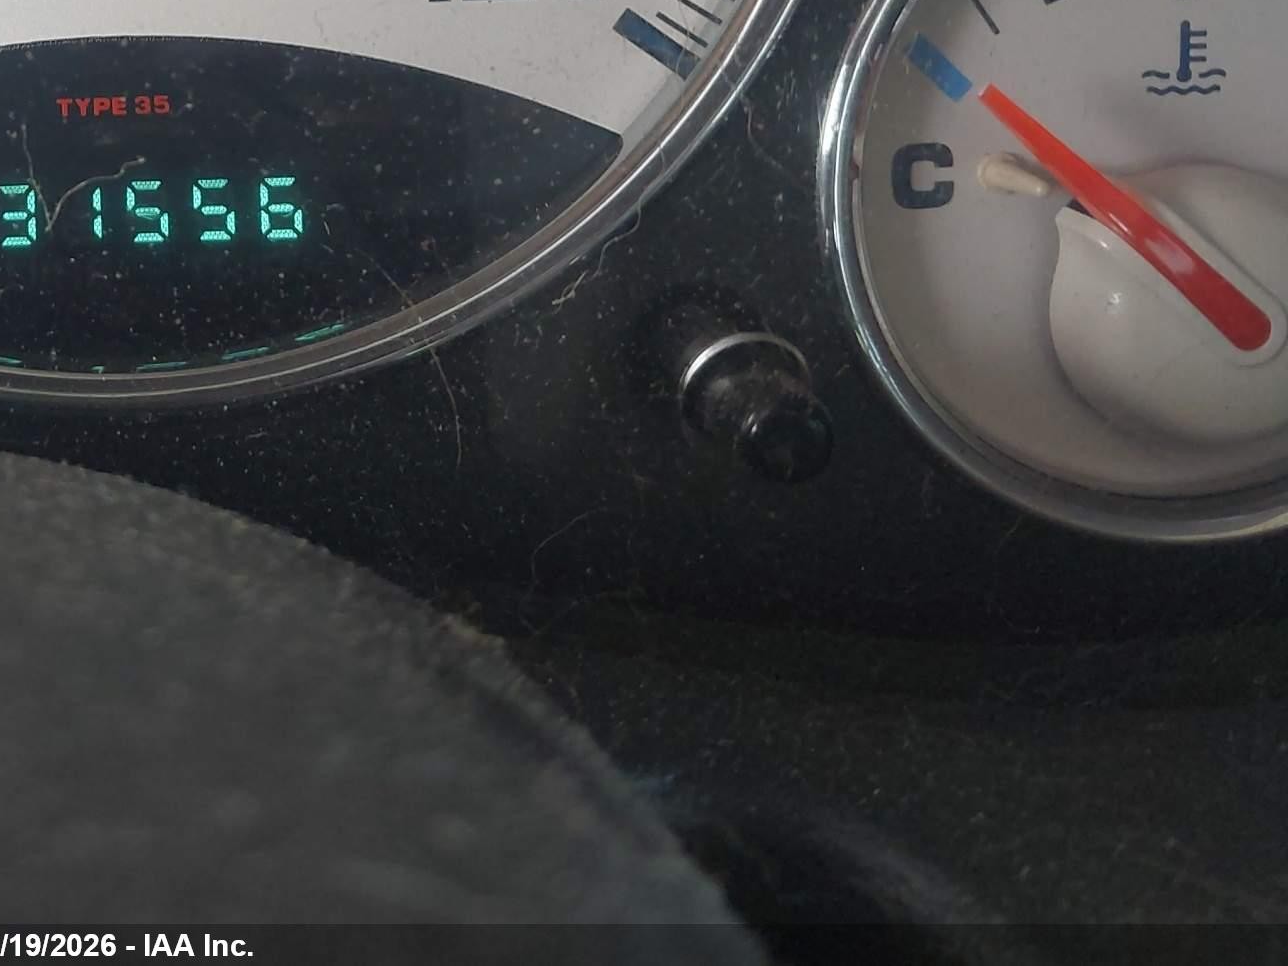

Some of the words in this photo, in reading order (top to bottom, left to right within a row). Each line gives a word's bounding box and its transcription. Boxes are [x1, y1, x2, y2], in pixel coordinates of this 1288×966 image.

[57, 97, 127, 118] TYPE
[135, 95, 171, 115] 35
[891, 142, 954, 210] C
